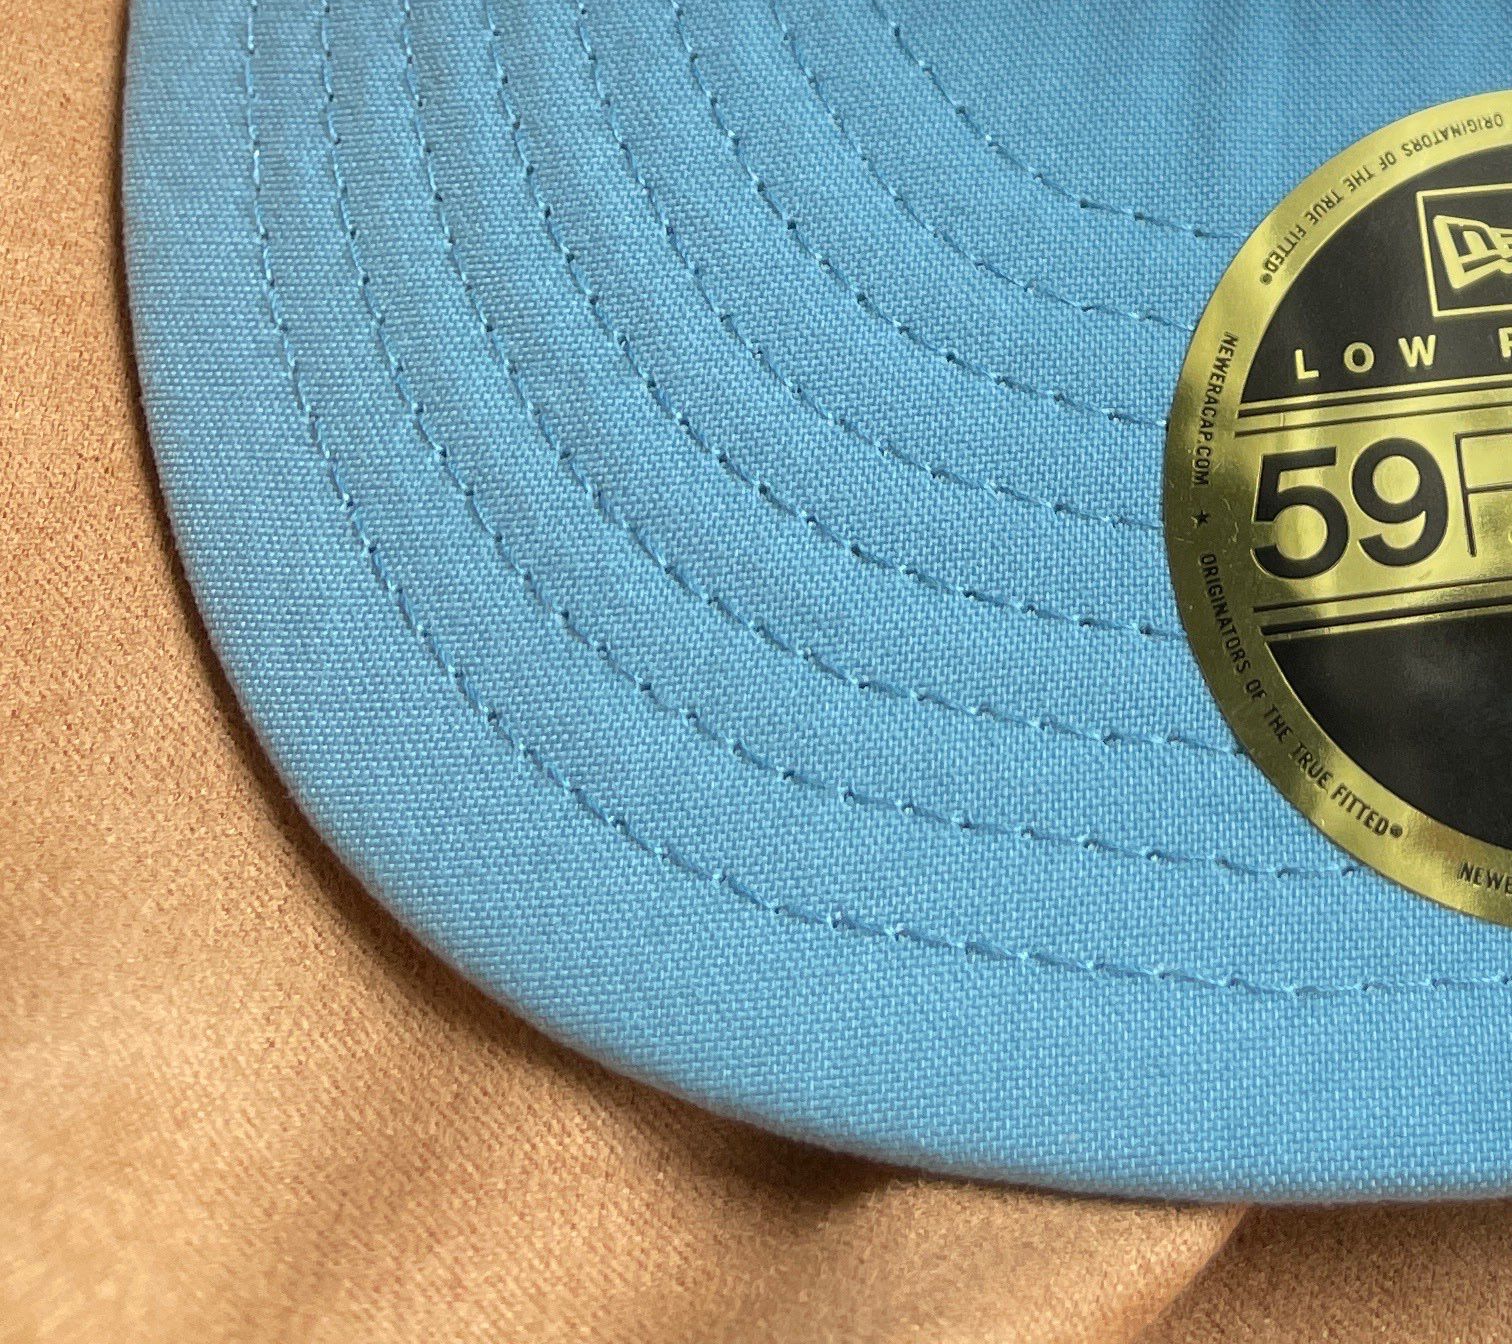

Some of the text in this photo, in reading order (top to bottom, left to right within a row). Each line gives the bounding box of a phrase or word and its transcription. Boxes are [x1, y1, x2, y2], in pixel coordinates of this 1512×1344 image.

[1402, 113, 1504, 159] ORIGINATORS
[1347, 164, 1376, 193] THE
[1380, 150, 1398, 173] OF
[1305, 190, 1344, 227] TRUE
[1294, 334, 1438, 381] LOW
[1200, 553, 1252, 673] ORIGINATORS
[1246, 679, 1267, 703] OF
[1263, 704, 1293, 743] THE
[1288, 741, 1332, 789] TRUE
